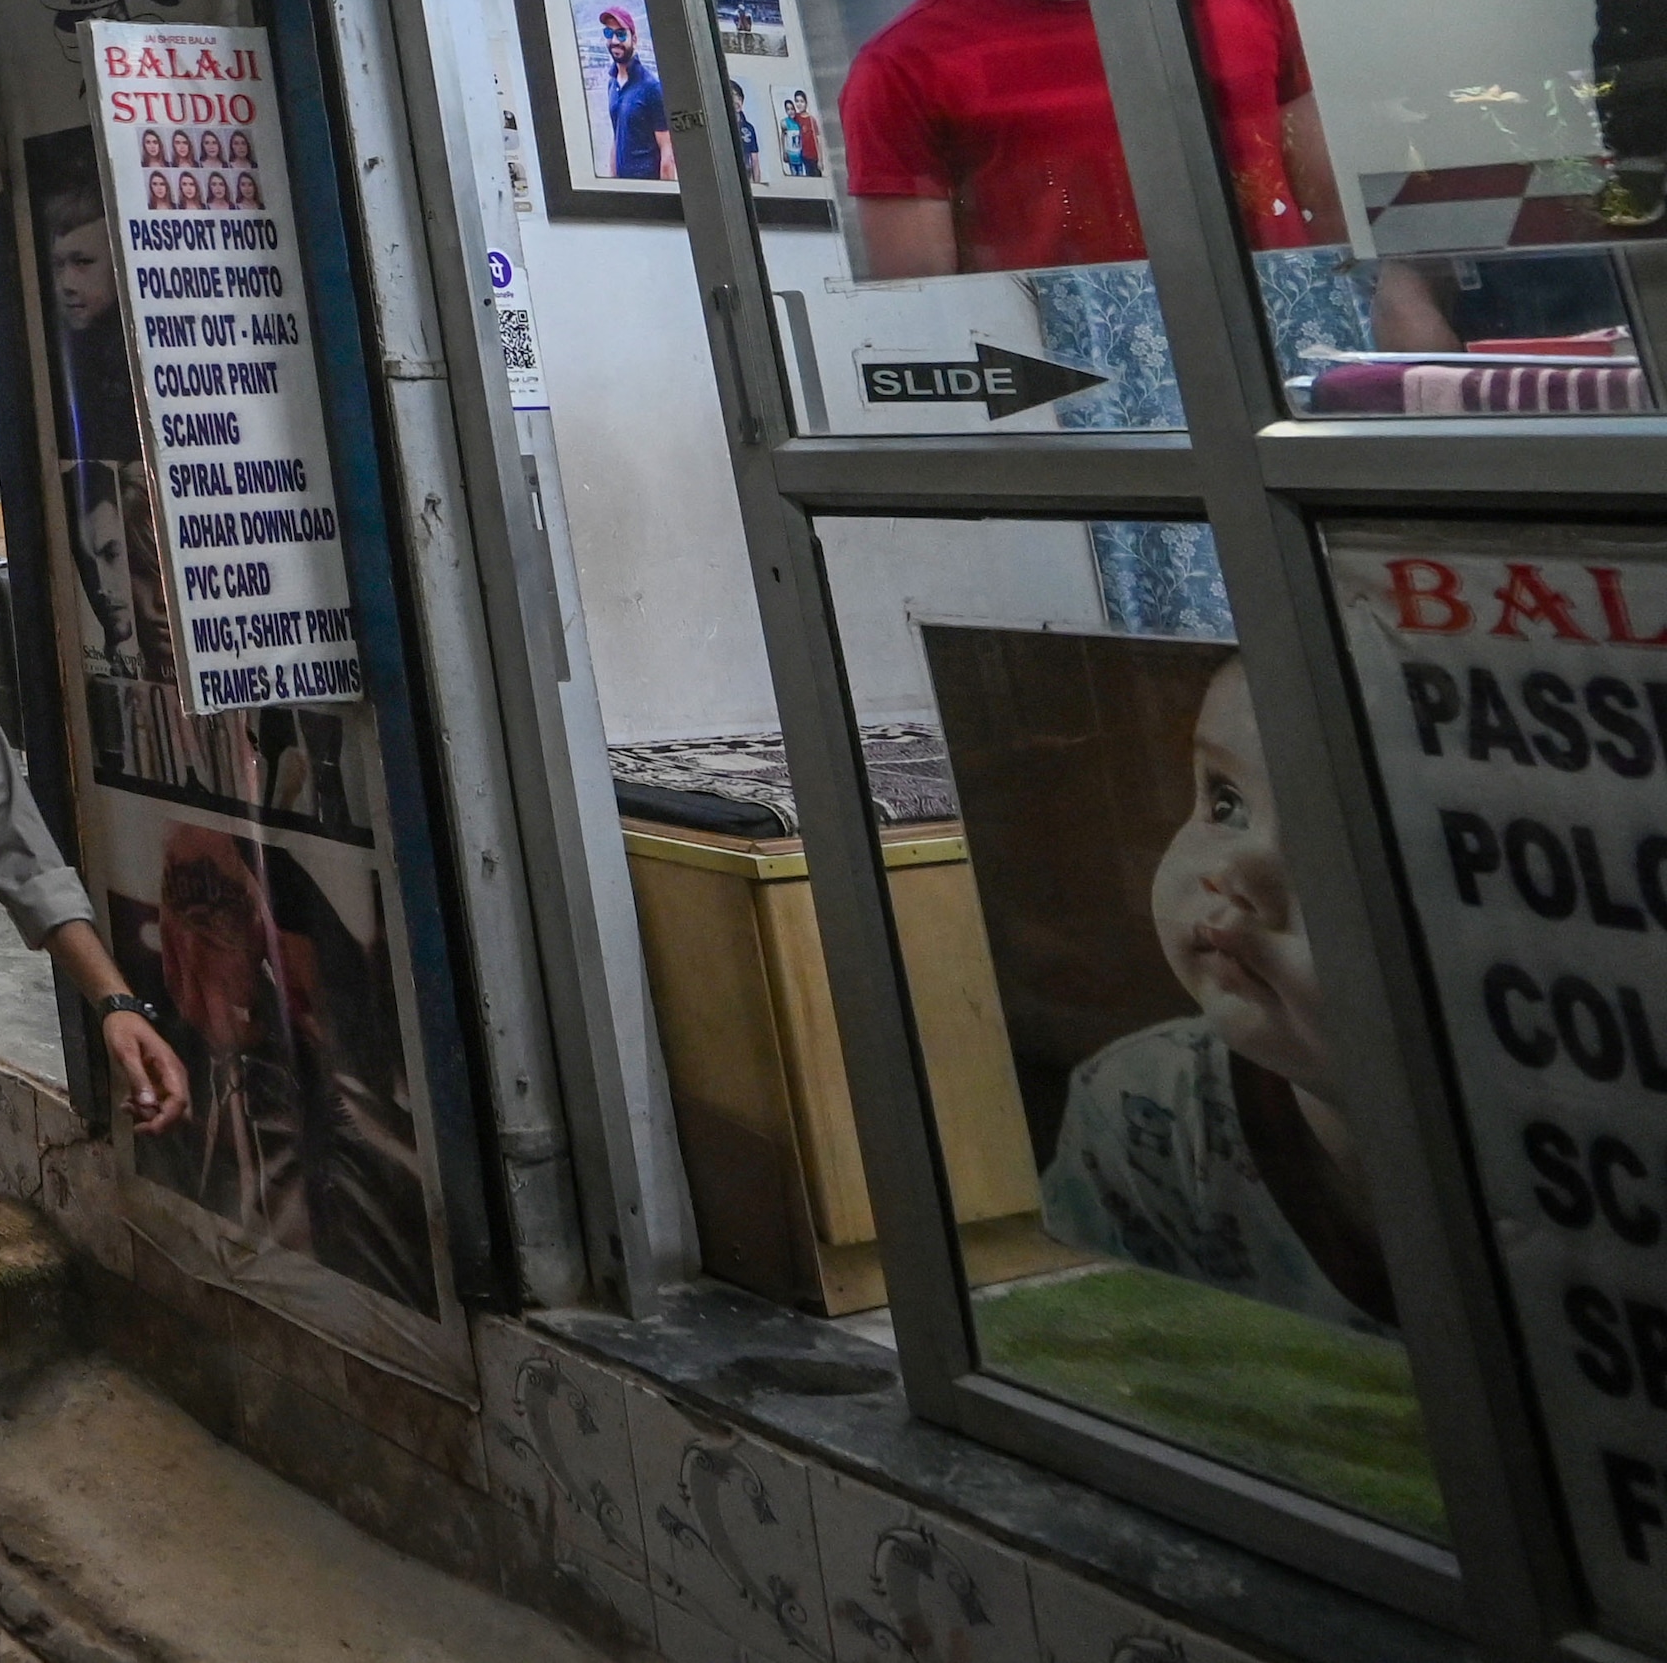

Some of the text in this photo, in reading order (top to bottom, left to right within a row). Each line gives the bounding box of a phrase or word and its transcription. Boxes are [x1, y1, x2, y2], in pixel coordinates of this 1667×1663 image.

[144, 35, 217, 45] JAI SHREE BALAJI
[105, 46, 262, 81] BALAJI
[111, 91, 256, 125] STUDIO
[129, 219, 278, 251] PASSPORT PHOTO
[137, 266, 283, 299] POLORIDE PHOTO
[144, 315, 196, 348] PRINT
[201, 314, 236, 347] OUT
[252, 313, 299, 346] A4/A3
[154, 362, 279, 397] COLOUR PRINT
[872, 365, 1018, 398] SLIDE
[162, 412, 241, 447] SCANING
[169, 459, 307, 498] SPIRAL BINDING
[179, 508, 336, 549] ADHAR DOWNLOAD
[184, 562, 271, 601] PVC CARD
[192, 611, 303, 660] MUG,T-SHIRT
[305, 608, 354, 644] PRINT
[200, 658, 360, 707] FRAMES & ALBUMS
[1402, 663, 1667, 779] PASS
